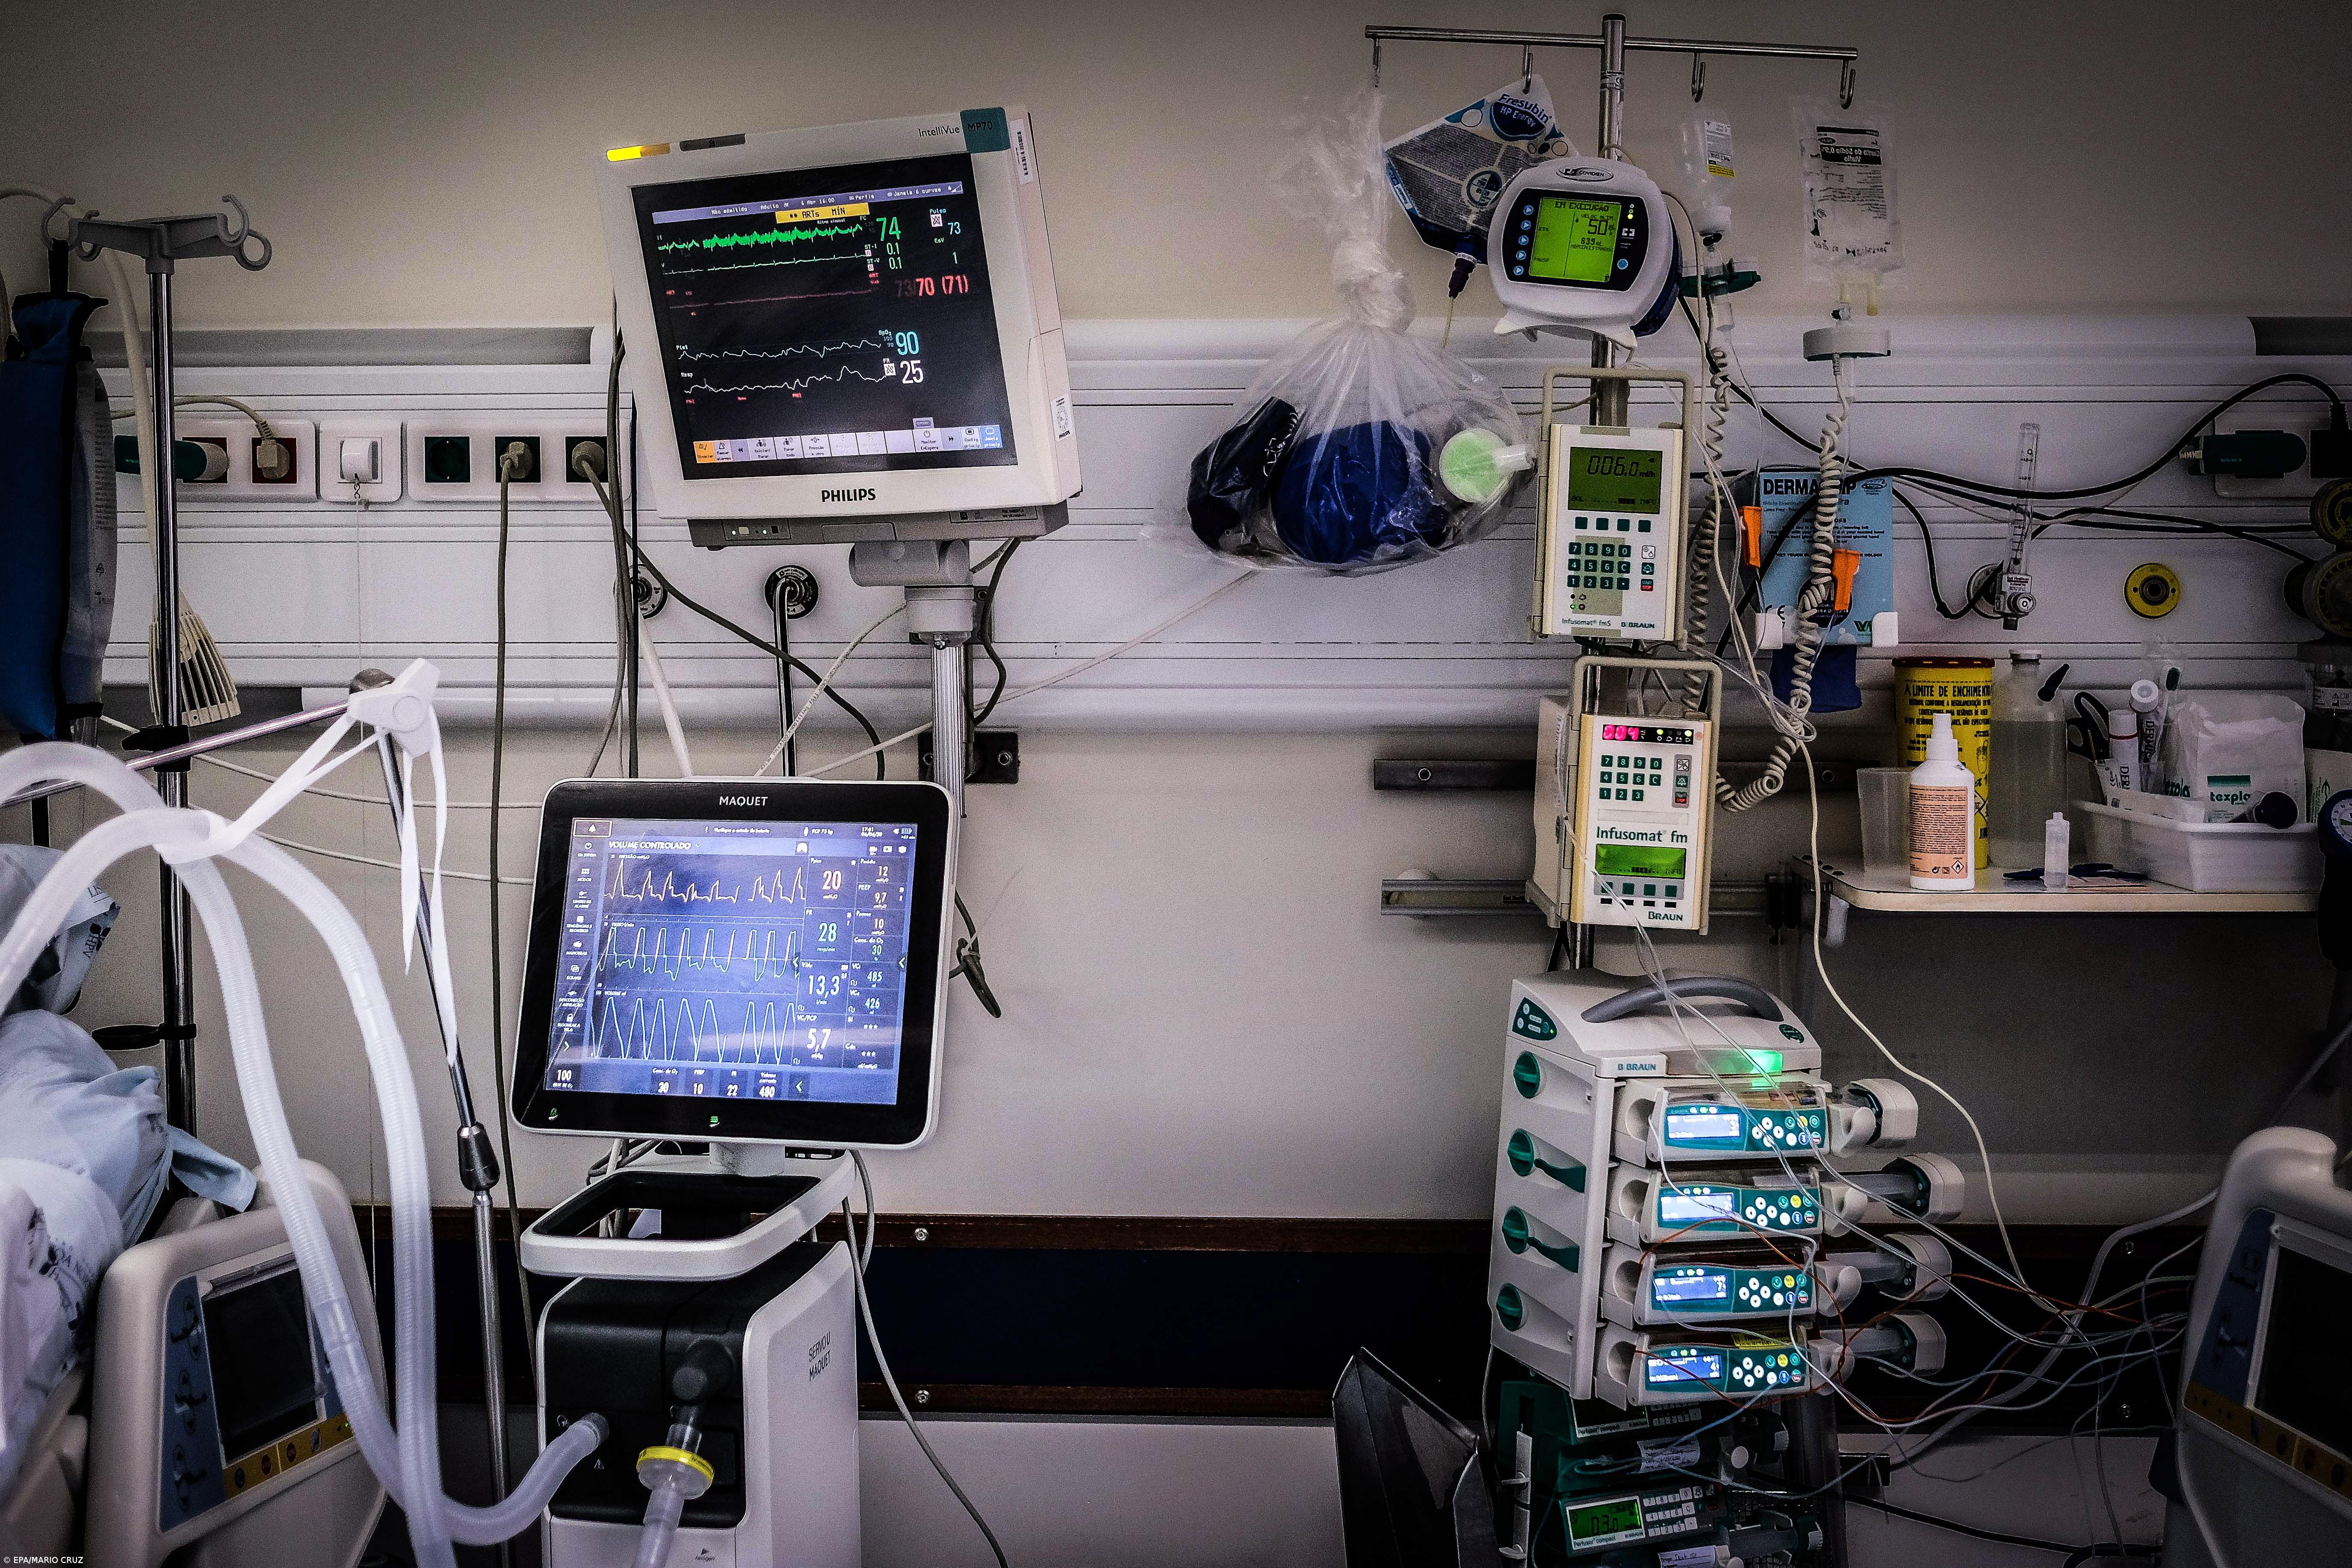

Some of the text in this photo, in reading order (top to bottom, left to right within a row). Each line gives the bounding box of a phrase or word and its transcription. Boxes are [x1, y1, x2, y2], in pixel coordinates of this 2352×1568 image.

[1500, 106, 1536, 127] HP Energy
[918, 121, 993, 138] IntelliVue MP70
[802, 206, 846, 219] ARTs MÍN
[876, 217, 902, 241] 74
[947, 222, 961, 235] 73
[1587, 218, 1608, 236] 50
[886, 242, 900, 255] 0.1
[889, 257, 902, 270] 0.1
[941, 273, 969, 294] (71)
[895, 331, 920, 355] 90
[899, 360, 924, 384] 25
[820, 488, 876, 503] PHILIPS
[1912, 684, 1935, 697] LIMITE
[1938, 685, 1948, 698] DE
[719, 795, 768, 806] MAQUET
[2210, 791, 2251, 805] texplo
[1670, 830, 1688, 843] fm
[608, 841, 691, 850] VOLUME CONTROLADO
[878, 865, 889, 877] 12
[822, 870, 842, 891] 20
[874, 892, 887, 904] 9,7
[1648, 911, 1683, 921] BRAUN
[874, 918, 885, 929] 10
[817, 922, 838, 943] 28
[872, 944, 883, 955] 30
[867, 970, 883, 982] 485
[808, 974, 841, 999] 13,3
[864, 998, 881, 1009] 426
[806, 1028, 832, 1052] 5,7
[557, 1069, 572, 1082] 100
[657, 1081, 670, 1093] 30
[693, 1082, 704, 1095] 10
[726, 1084, 738, 1096] 22
[759, 1085, 776, 1098] 480
[809, 1349, 831, 1382] MAQUET
